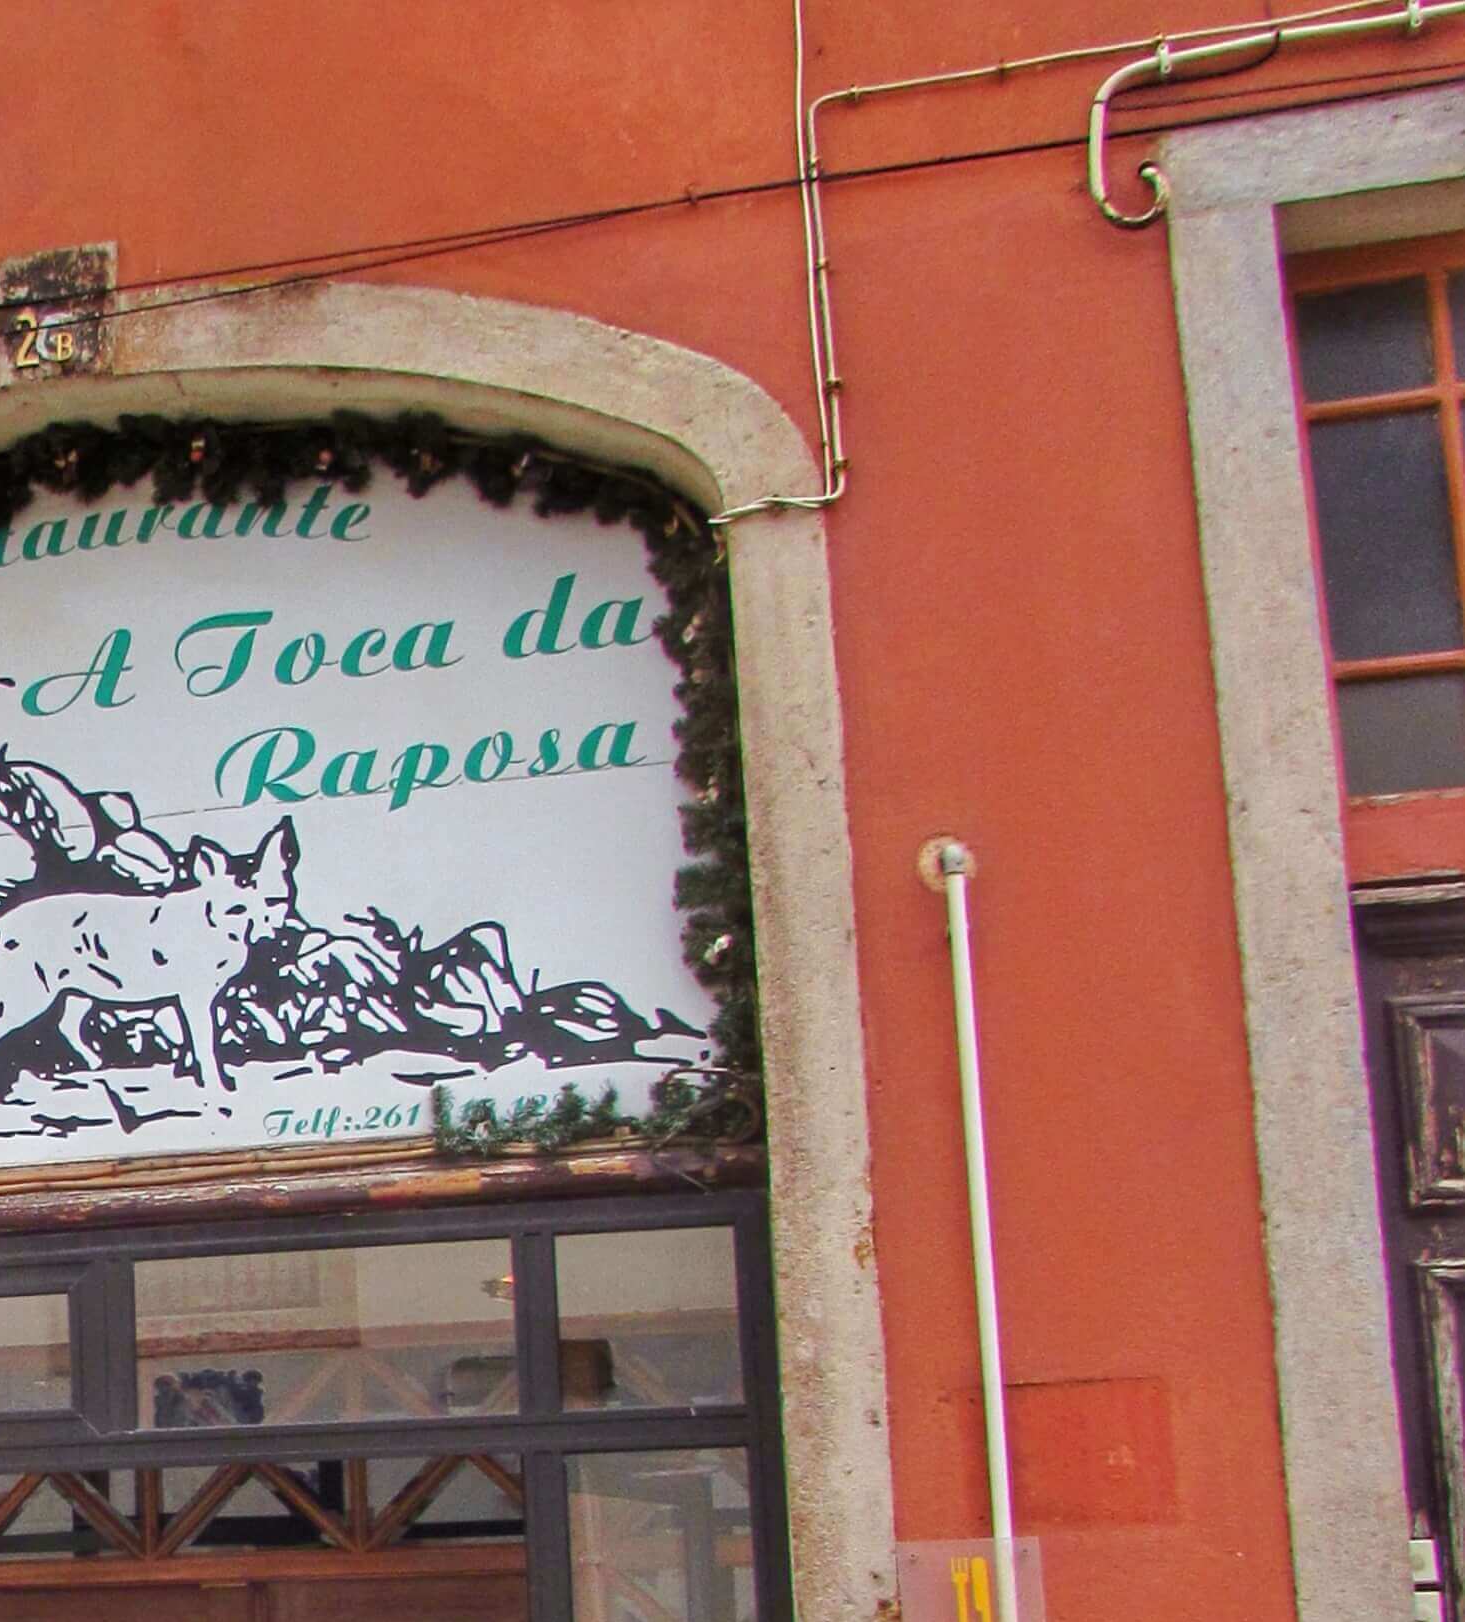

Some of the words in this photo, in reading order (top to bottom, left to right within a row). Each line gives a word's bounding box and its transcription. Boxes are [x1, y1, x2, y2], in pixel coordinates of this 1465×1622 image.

[21, 628, 136, 716] A
[175, 610, 465, 697] Toca
[502, 573, 655, 659] da
[214, 721, 648, 812] Raposa
